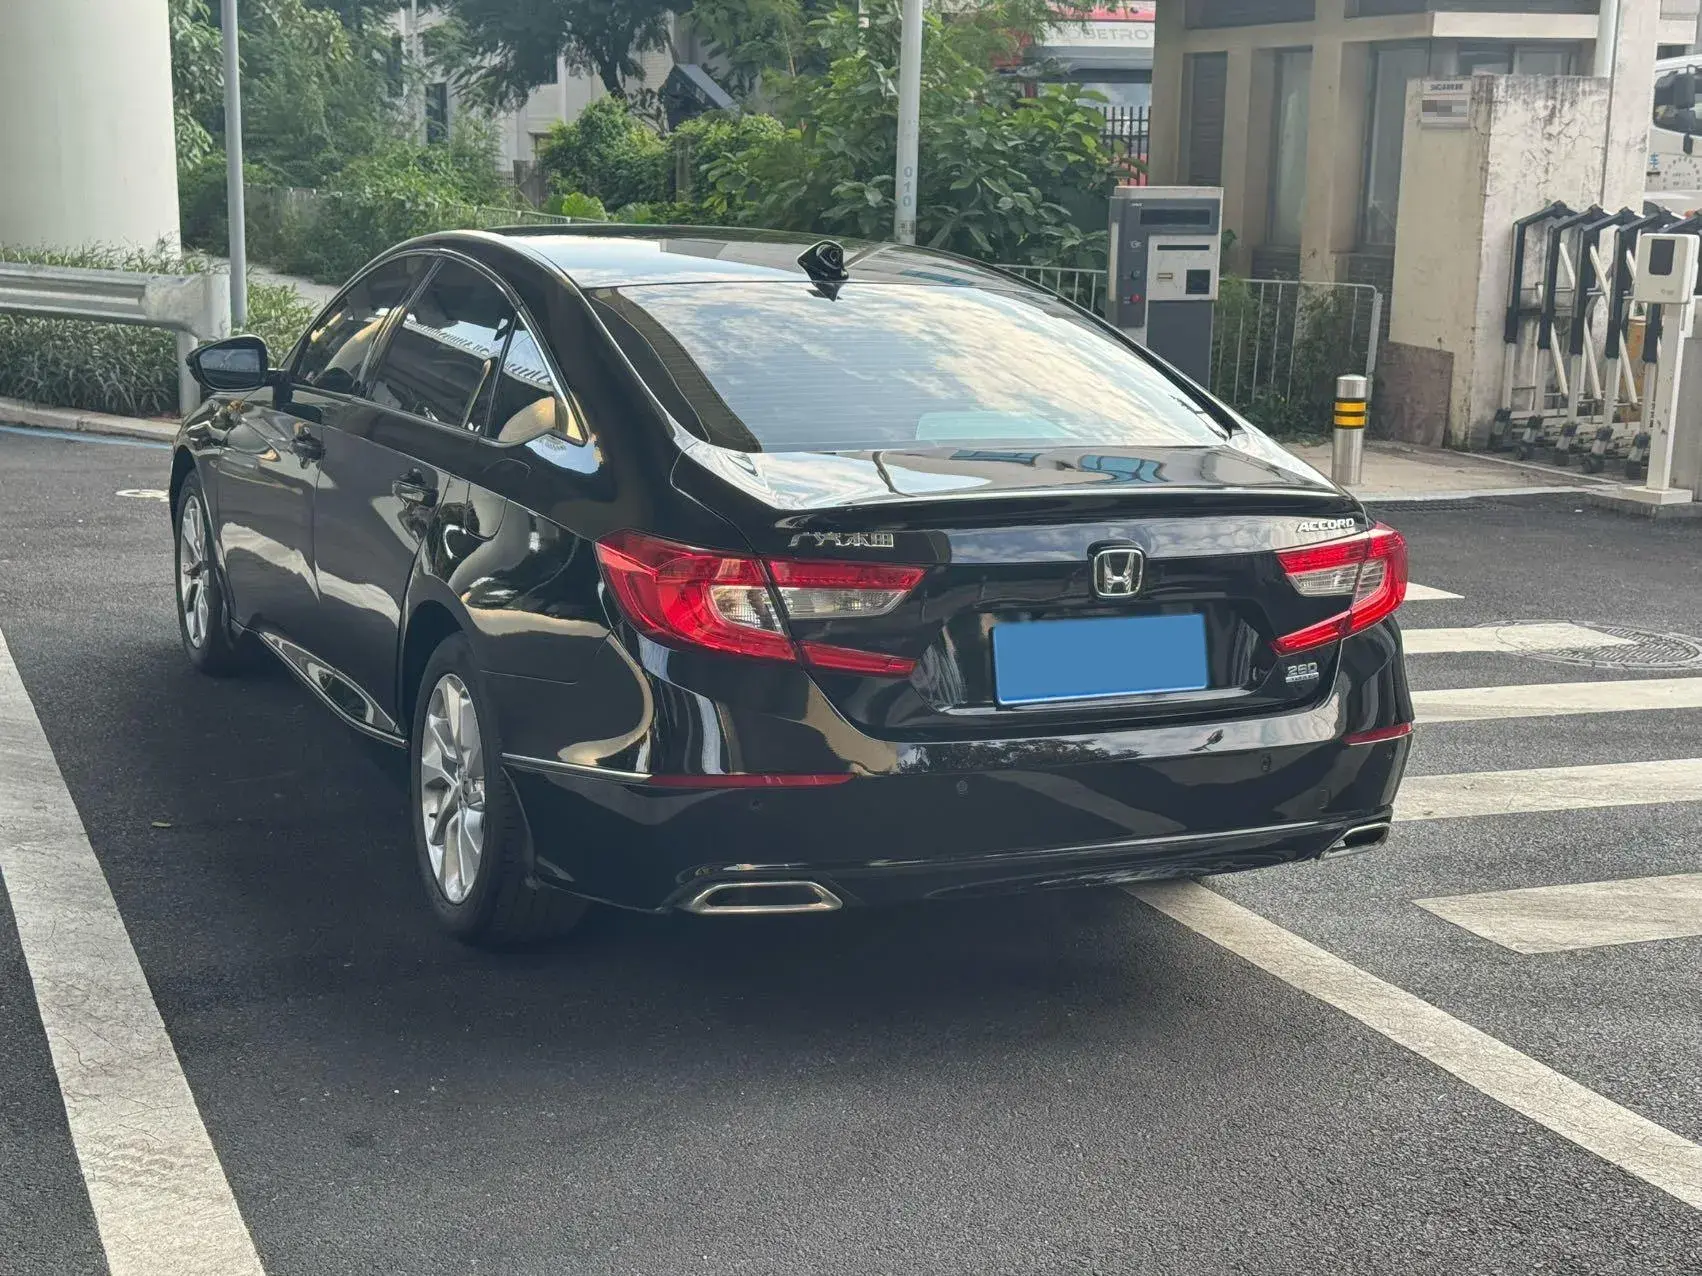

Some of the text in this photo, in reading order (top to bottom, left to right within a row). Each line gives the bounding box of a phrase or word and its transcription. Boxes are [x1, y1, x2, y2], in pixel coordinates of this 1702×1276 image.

[903, 166, 913, 207] 010
[1297, 517, 1355, 532] ACCORD
[788, 531, 894, 547] 广汽本田
[1287, 662, 1318, 677] 260
